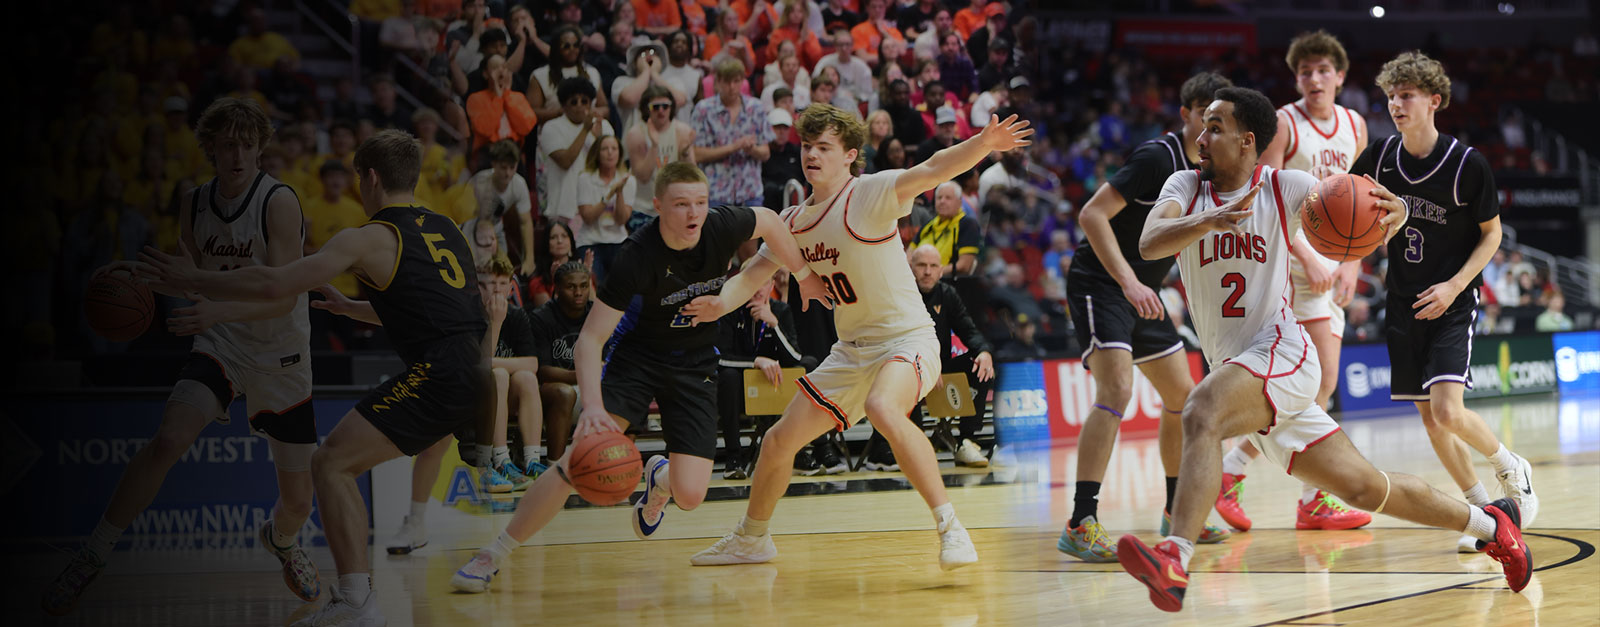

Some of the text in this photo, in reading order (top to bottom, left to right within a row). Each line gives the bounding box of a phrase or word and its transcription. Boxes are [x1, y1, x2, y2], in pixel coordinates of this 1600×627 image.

[420, 232, 466, 289] 5
[800, 242, 840, 266] Valley
[1199, 232, 1267, 268] LIONS
[1404, 226, 1425, 264] 3
[1221, 272, 1246, 317] 2
[57, 436, 259, 465] NORTWEST
